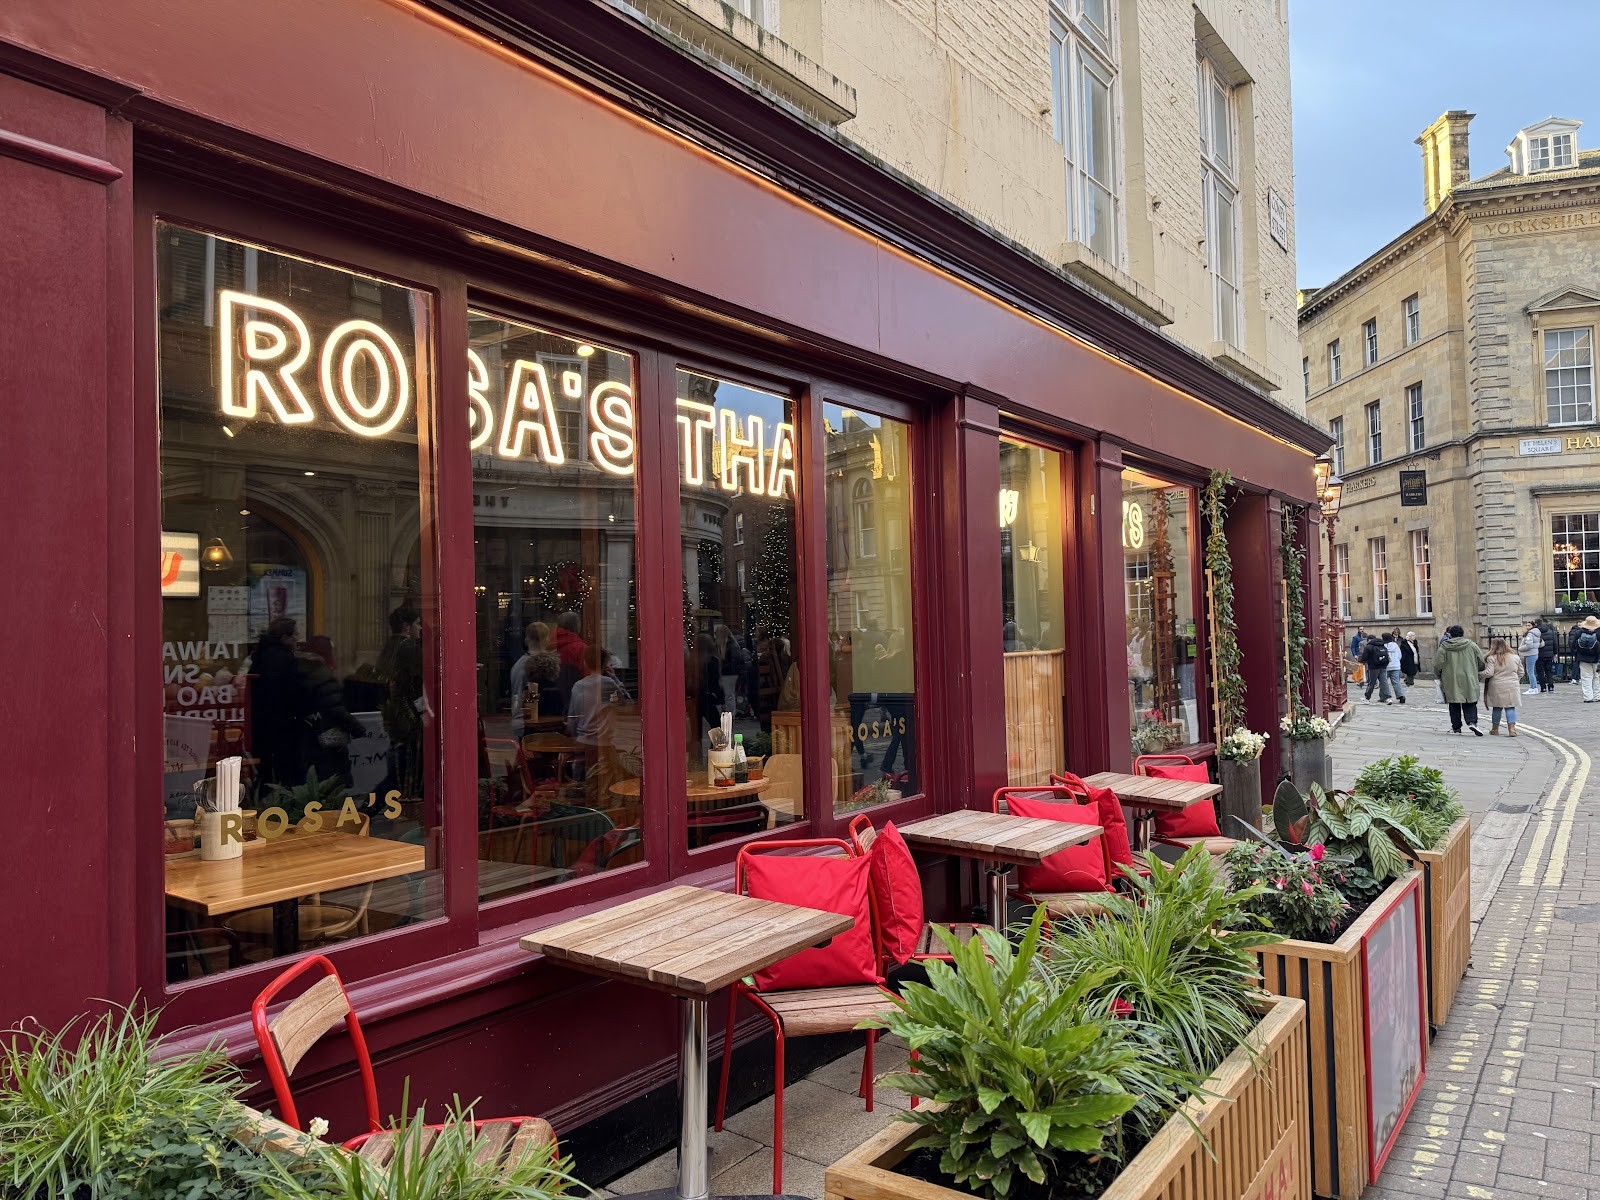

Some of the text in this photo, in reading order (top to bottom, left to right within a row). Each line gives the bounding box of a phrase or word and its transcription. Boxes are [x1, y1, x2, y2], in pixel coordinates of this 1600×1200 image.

[1486, 211, 1600, 236] YORKSHIRE
[846, 716, 906, 743] ROSA'S
[220, 789, 403, 846] ROSA'S
[1254, 1142, 1294, 1200] HAI
